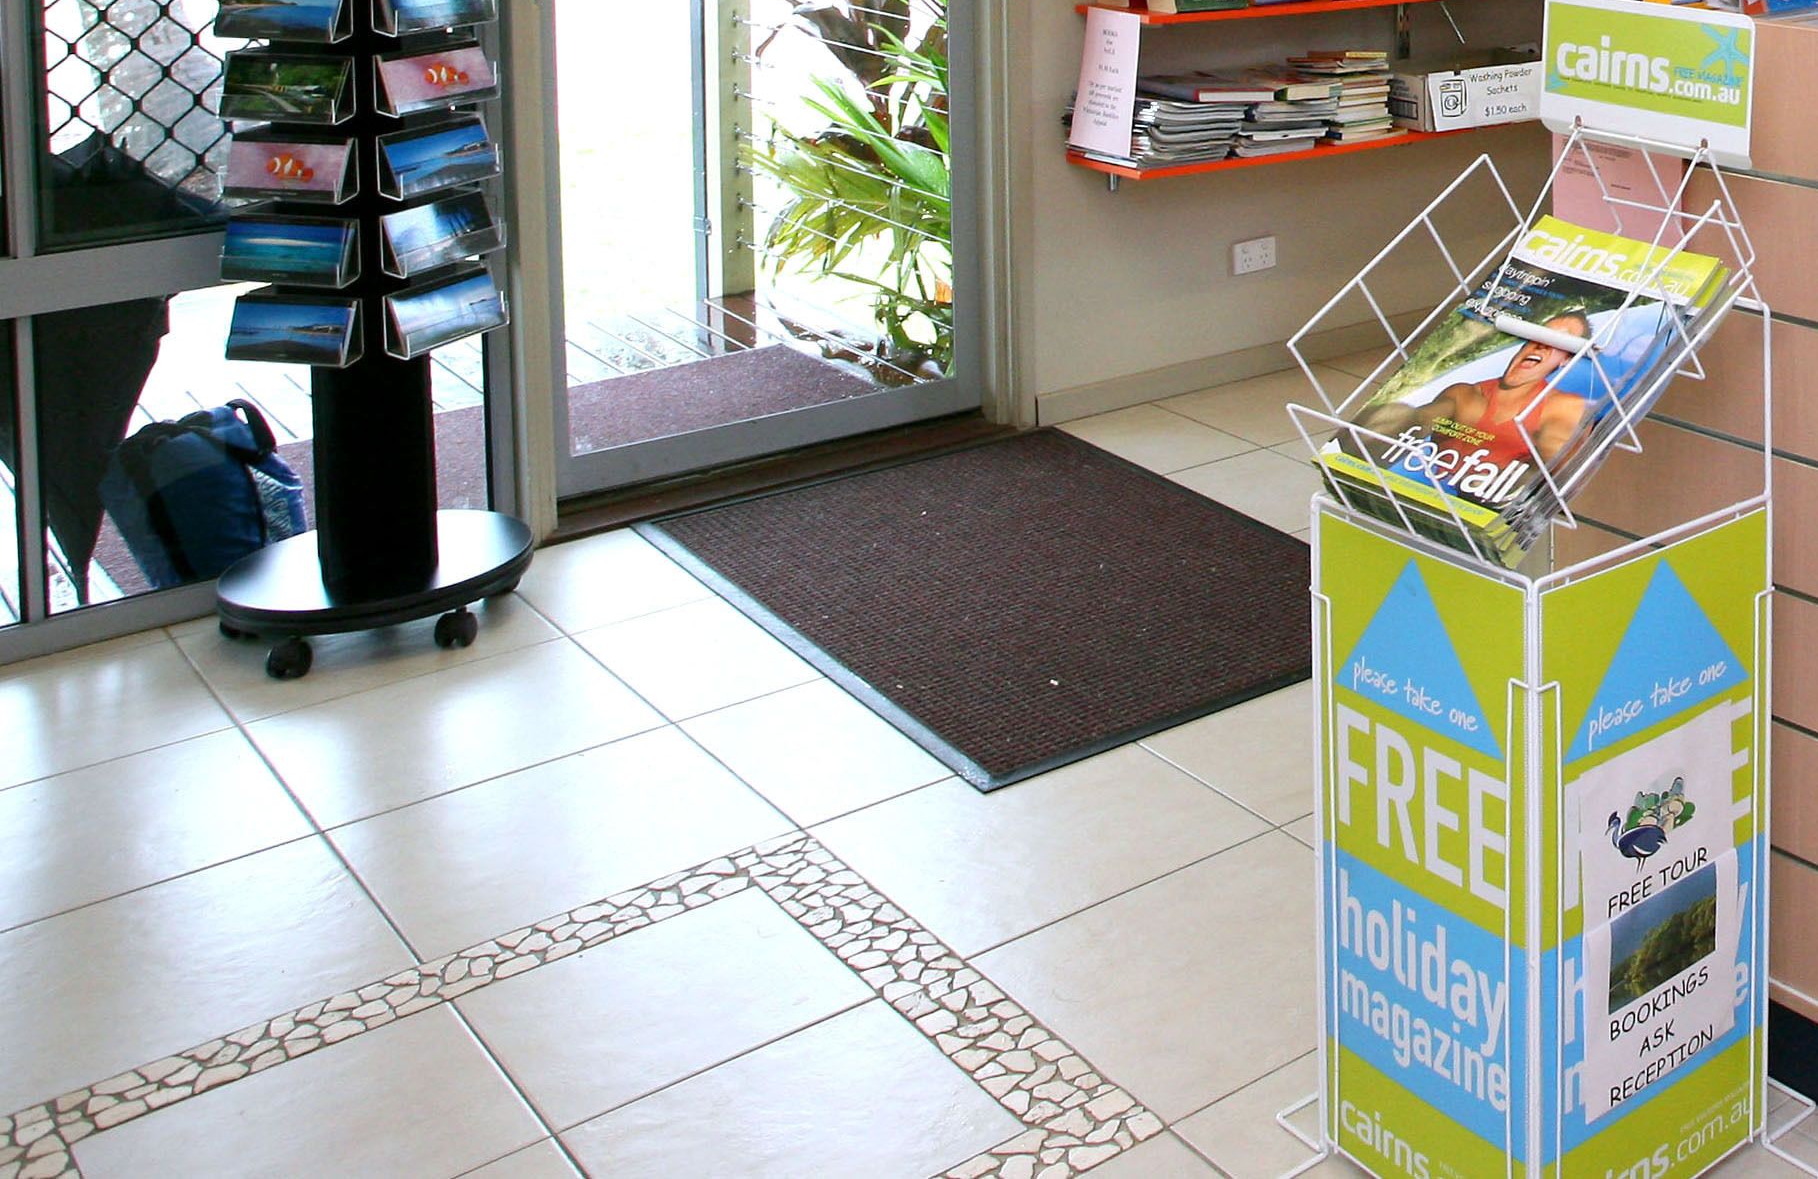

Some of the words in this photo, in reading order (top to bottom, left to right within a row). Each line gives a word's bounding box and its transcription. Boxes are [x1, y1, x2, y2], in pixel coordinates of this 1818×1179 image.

[1469, 70, 1503, 84] Washing
[1504, 67, 1533, 79] Powder
[1487, 83, 1518, 96] Sachets
[1556, 35, 1742, 106] cairns.com.au
[1509, 104, 1527, 115] each
[1353, 656, 1398, 694] please
[1404, 678, 1444, 716] take
[1449, 708, 1479, 732] one
[1587, 698, 1643, 752] please
[1650, 676, 1693, 709] take
[1699, 660, 1728, 686] one
[1337, 702, 1508, 911] FREE
[1608, 876, 1652, 918] FREE
[1659, 847, 1708, 885] TOUR
[1340, 868, 1507, 1057] holiday
[1342, 967, 1510, 1111] magazine
[1609, 966, 1708, 1041] BOOKINGS
[1640, 1019, 1675, 1057] ASK
[1610, 1024, 1713, 1107] RECEPTION
